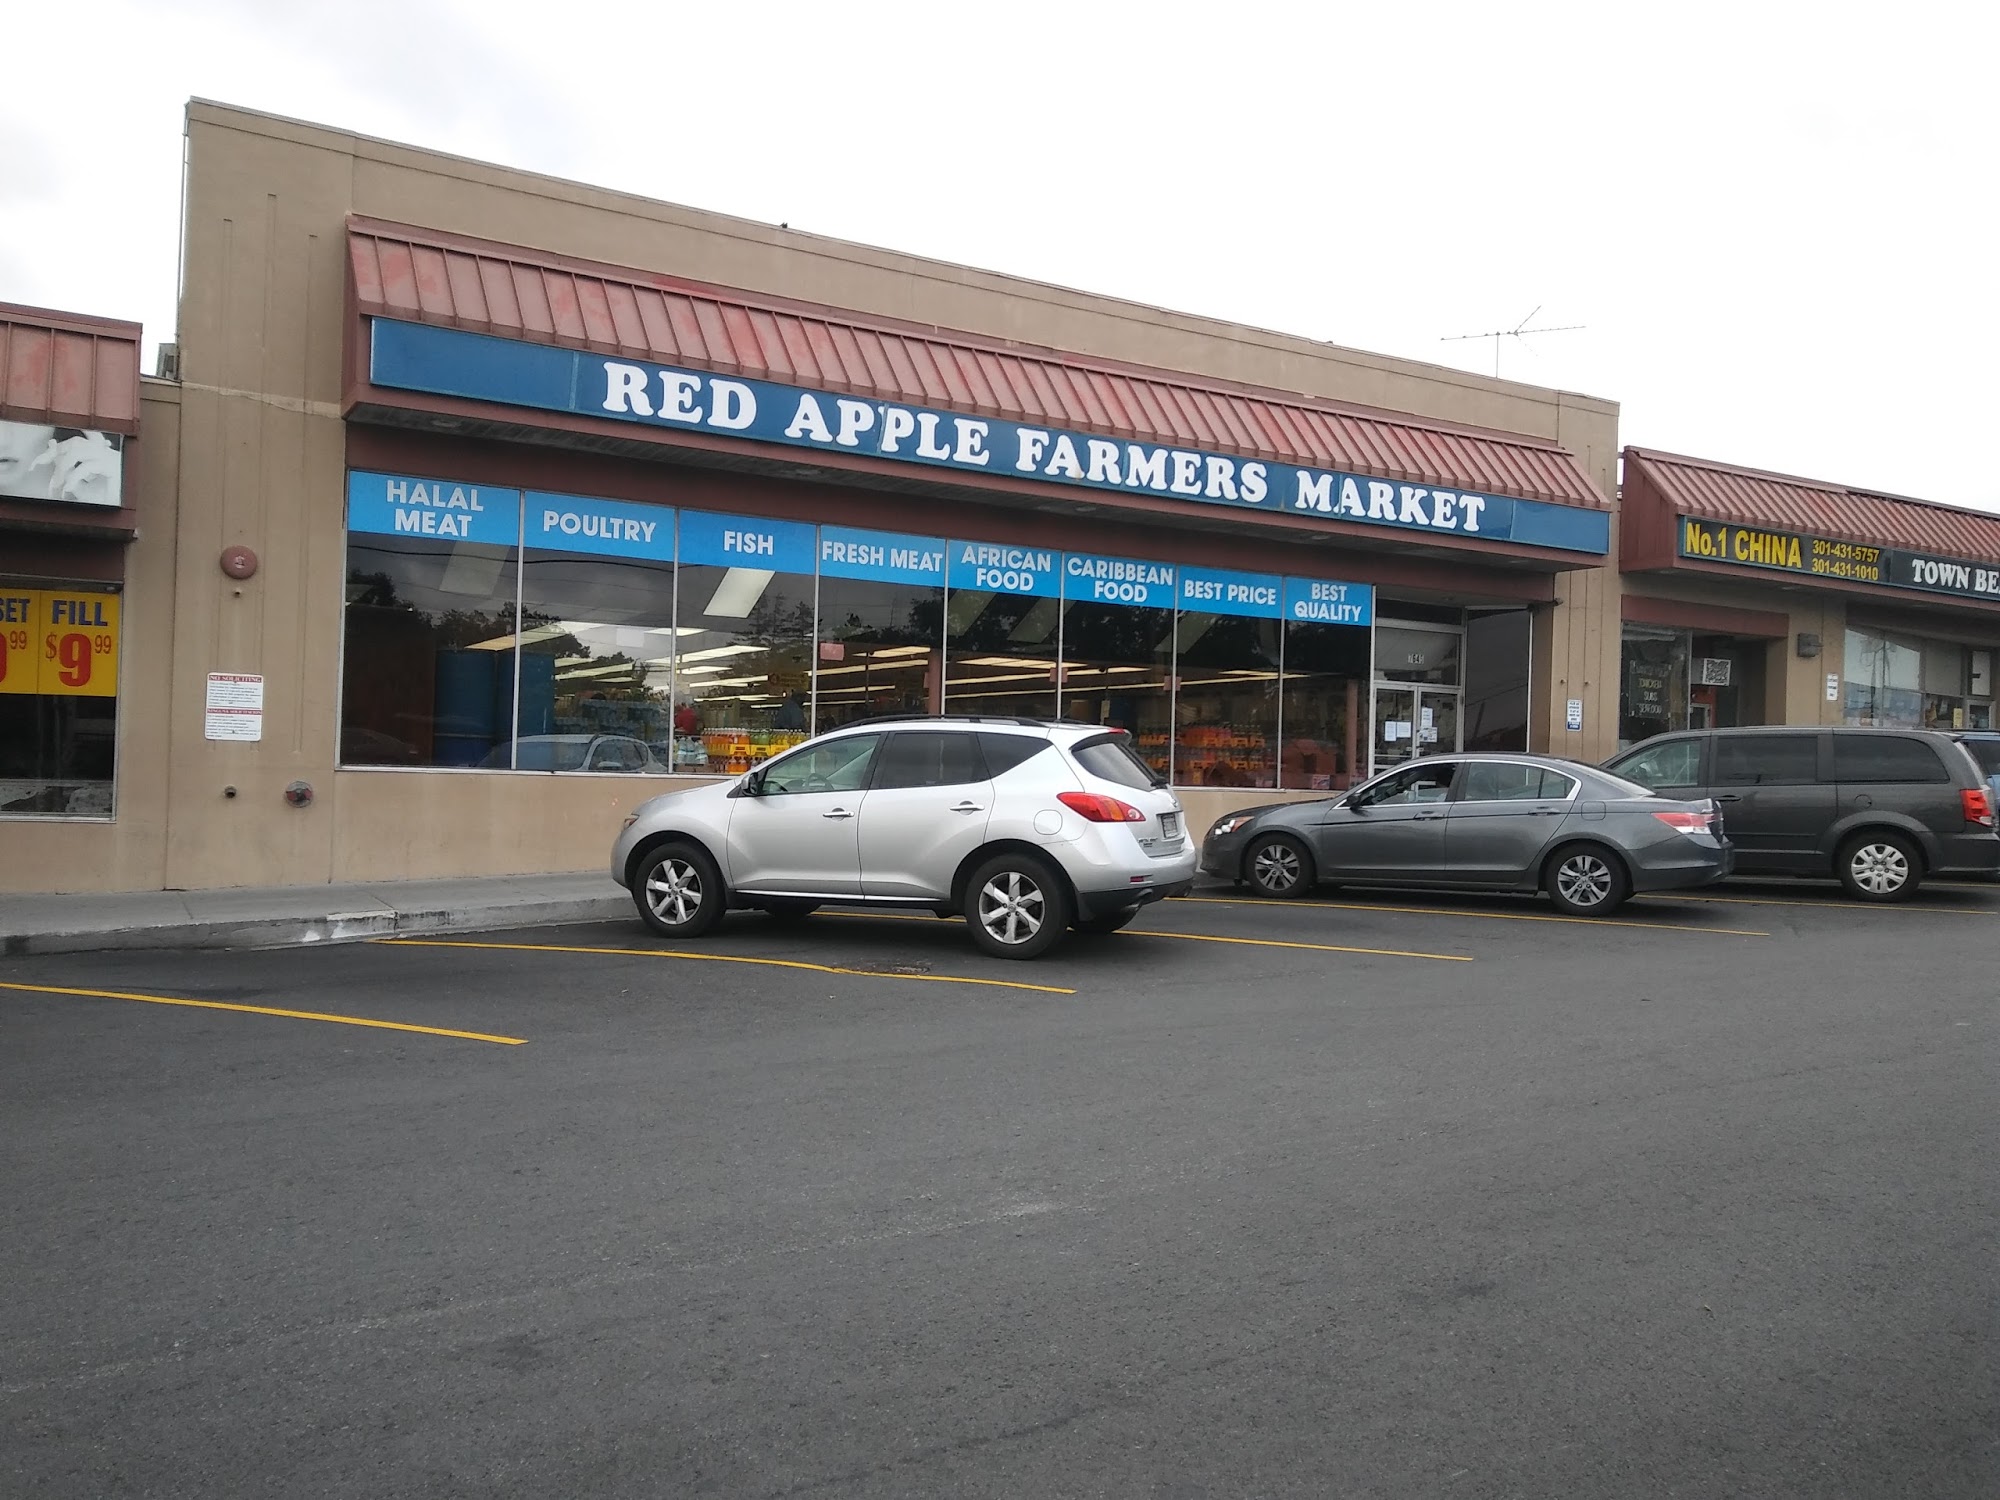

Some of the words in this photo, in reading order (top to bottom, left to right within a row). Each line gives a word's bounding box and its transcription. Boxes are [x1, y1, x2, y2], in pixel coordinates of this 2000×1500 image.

[602, 361, 757, 430] RED
[784, 393, 991, 466] APPLE
[1015, 427, 1269, 503] FARMERS
[1294, 469, 1487, 532] MARKET
[386, 480, 484, 511] HALAL
[394, 508, 473, 537] MEAT
[542, 510, 656, 543] POULTRY
[723, 530, 774, 556] FISH
[1686, 522, 1727, 558] No.1
[1734, 529, 1802, 569] CHINA
[1812, 539, 1880, 563] 301-431-5757
[821, 541, 884, 565] FRESH
[890, 549, 943, 573] MEAT
[961, 545, 1051, 573] AFRICAN
[1811, 559, 1879, 582] 301-431-1010
[976, 568, 1034, 591] FOOD
[1067, 557, 1173, 586] CARIBBEAN
[1912, 558, 1971, 590] TOWN
[1975, 568, 2000, 594] BE
[1094, 581, 1148, 603] FOOD
[1184, 580, 1223, 600] BEST
[1227, 585, 1276, 606] PRICE
[1311, 584, 1347, 603] BEST
[52, 600, 108, 627] FILL
[1294, 601, 1361, 622] QUALITY
